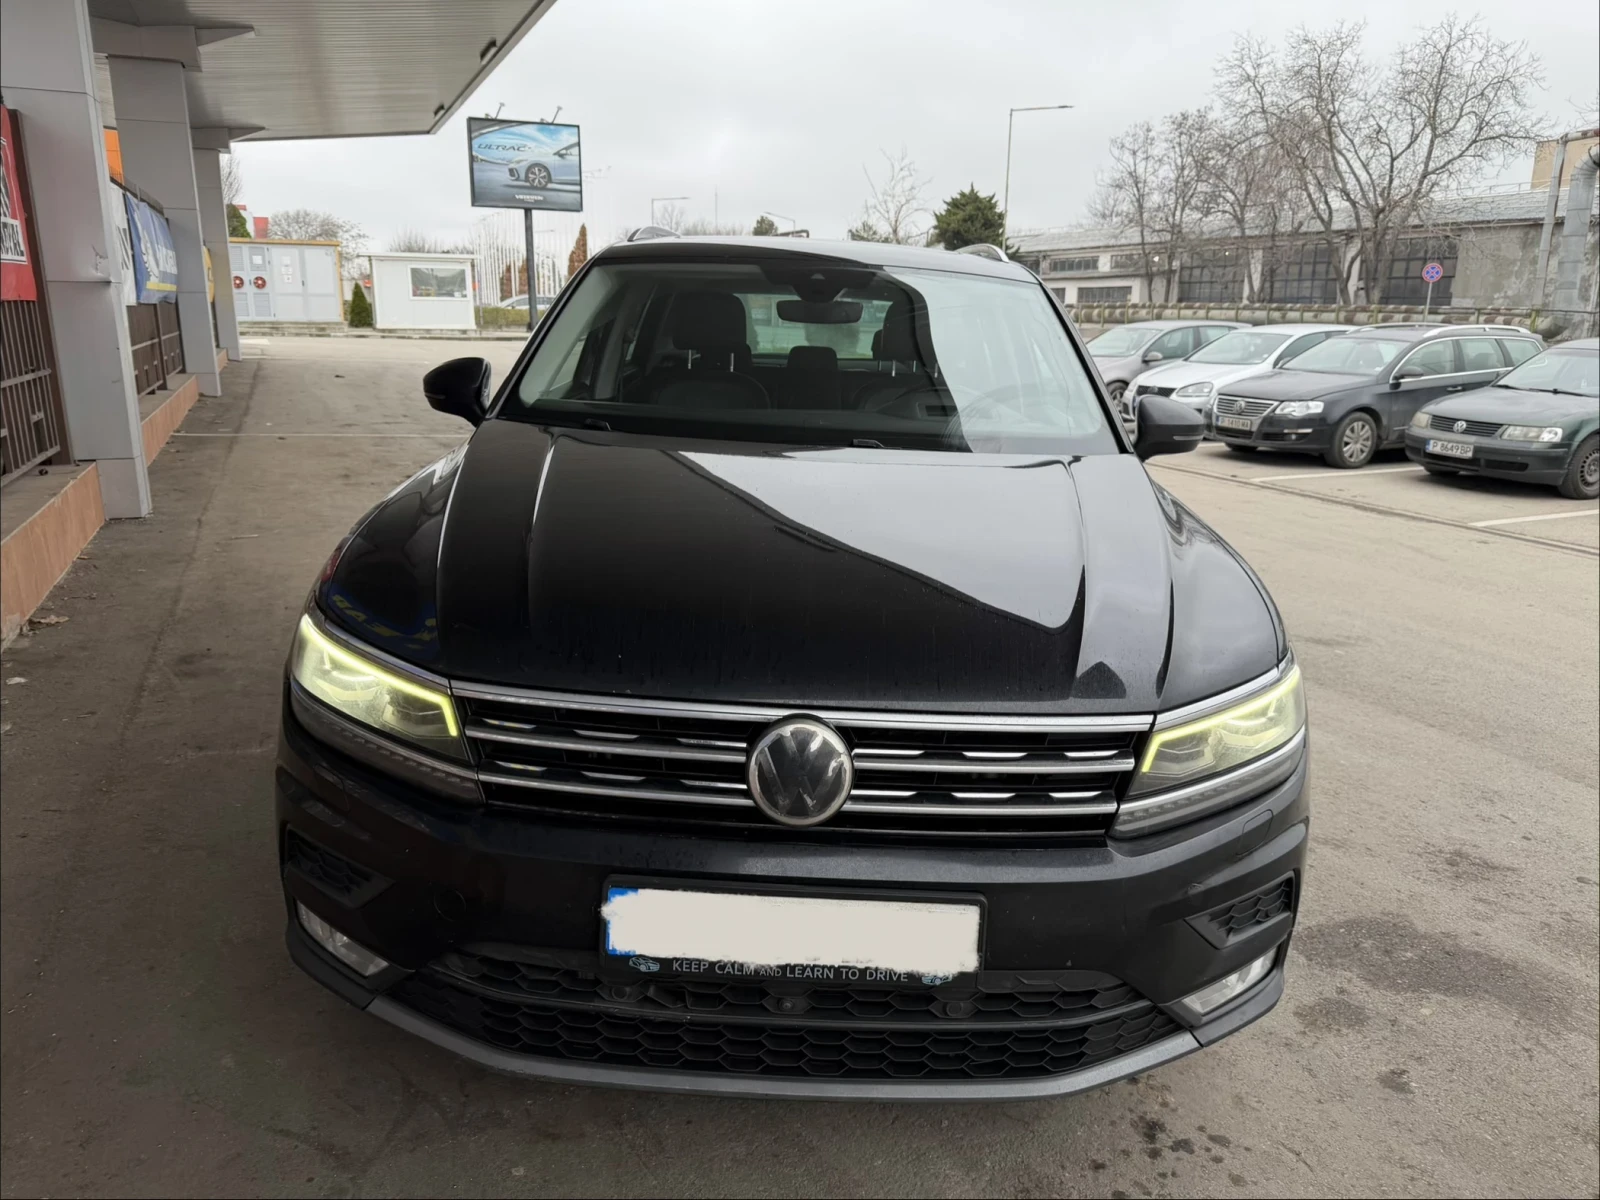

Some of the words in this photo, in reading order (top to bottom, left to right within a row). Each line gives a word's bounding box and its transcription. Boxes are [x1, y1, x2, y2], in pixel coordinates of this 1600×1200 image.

[672, 960, 709, 973] KEEP
[715, 962, 755, 976] CALM
[760, 968, 782, 977] AND
[786, 966, 834, 979] LEARN
[840, 968, 859, 980] TO
[866, 969, 909, 982] DRIVE
